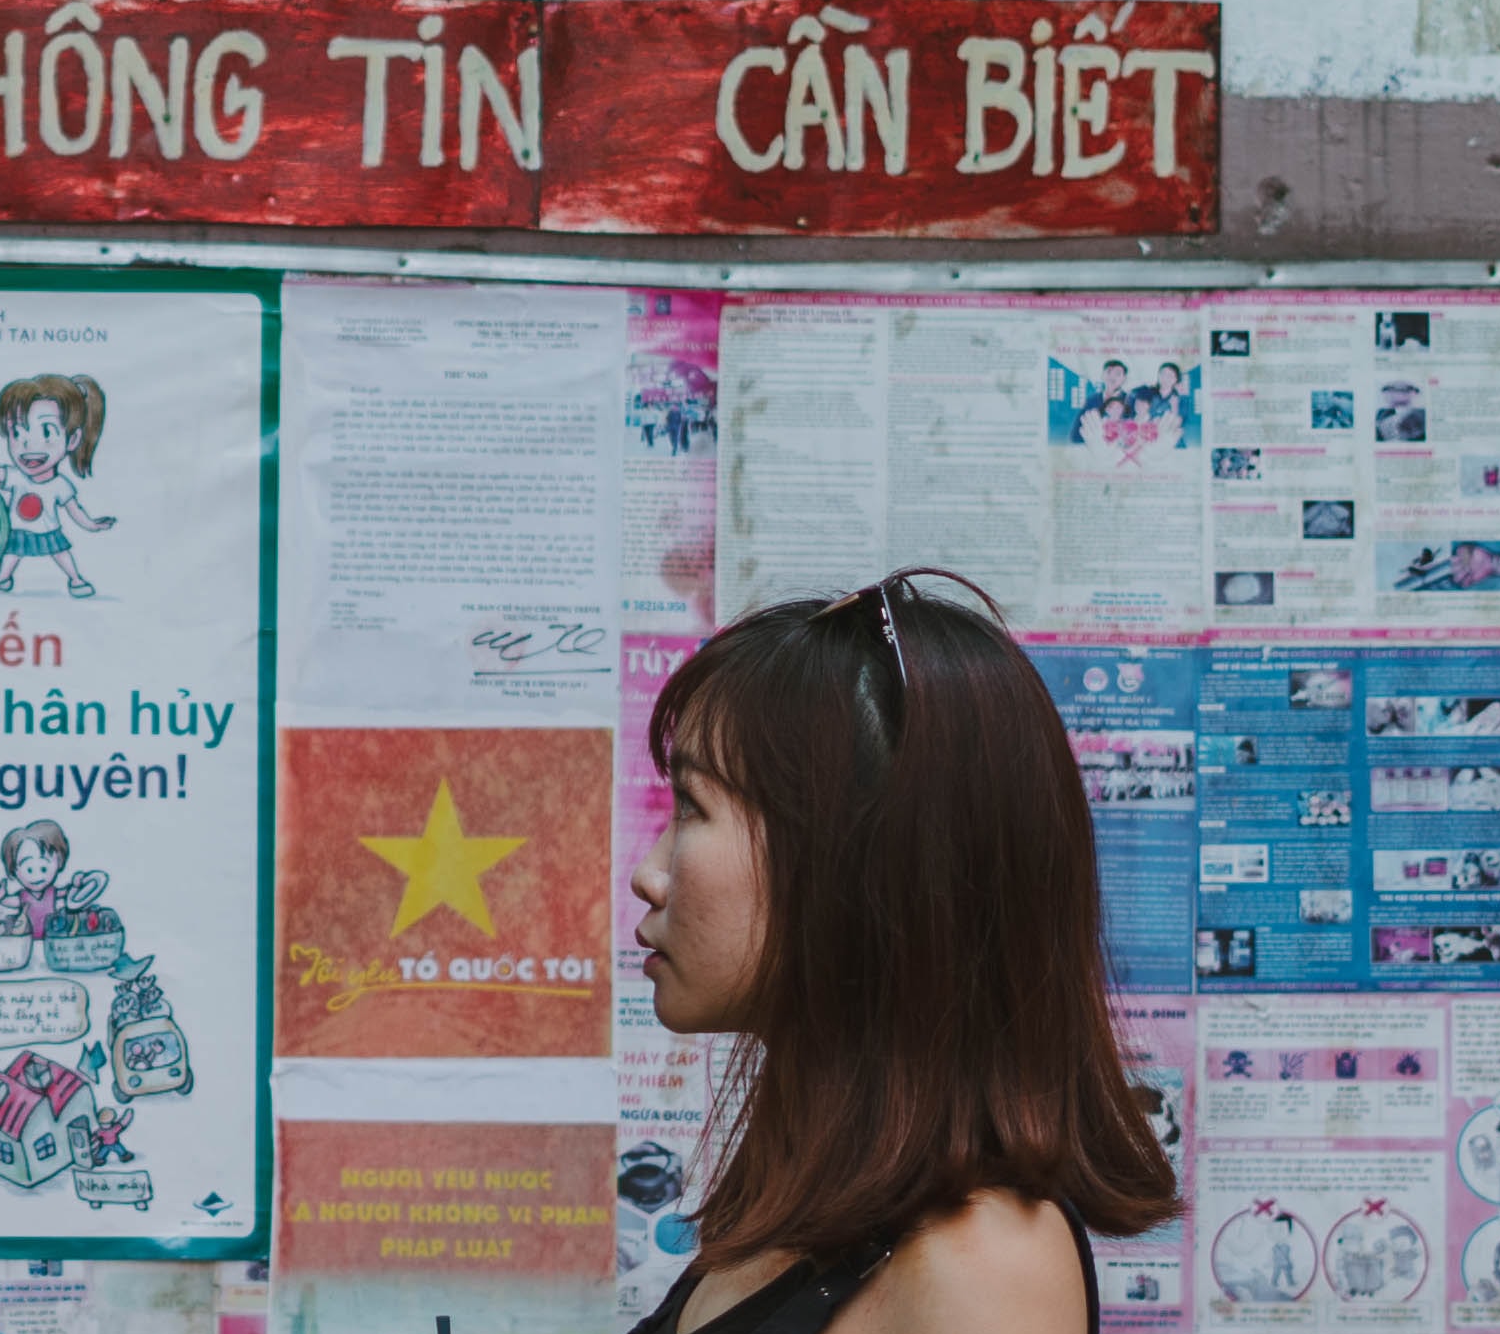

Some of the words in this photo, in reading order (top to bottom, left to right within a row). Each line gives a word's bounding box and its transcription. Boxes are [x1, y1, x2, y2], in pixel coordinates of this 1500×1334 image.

[715, 6, 910, 173] CẦN
[955, 1, 1215, 181] BIẾT
[9, 327, 37, 343] TẠI
[130, 689, 234, 748] hủy
[543, 954, 597, 981] TÔI
[78, 1175, 117, 1195] Nhà
